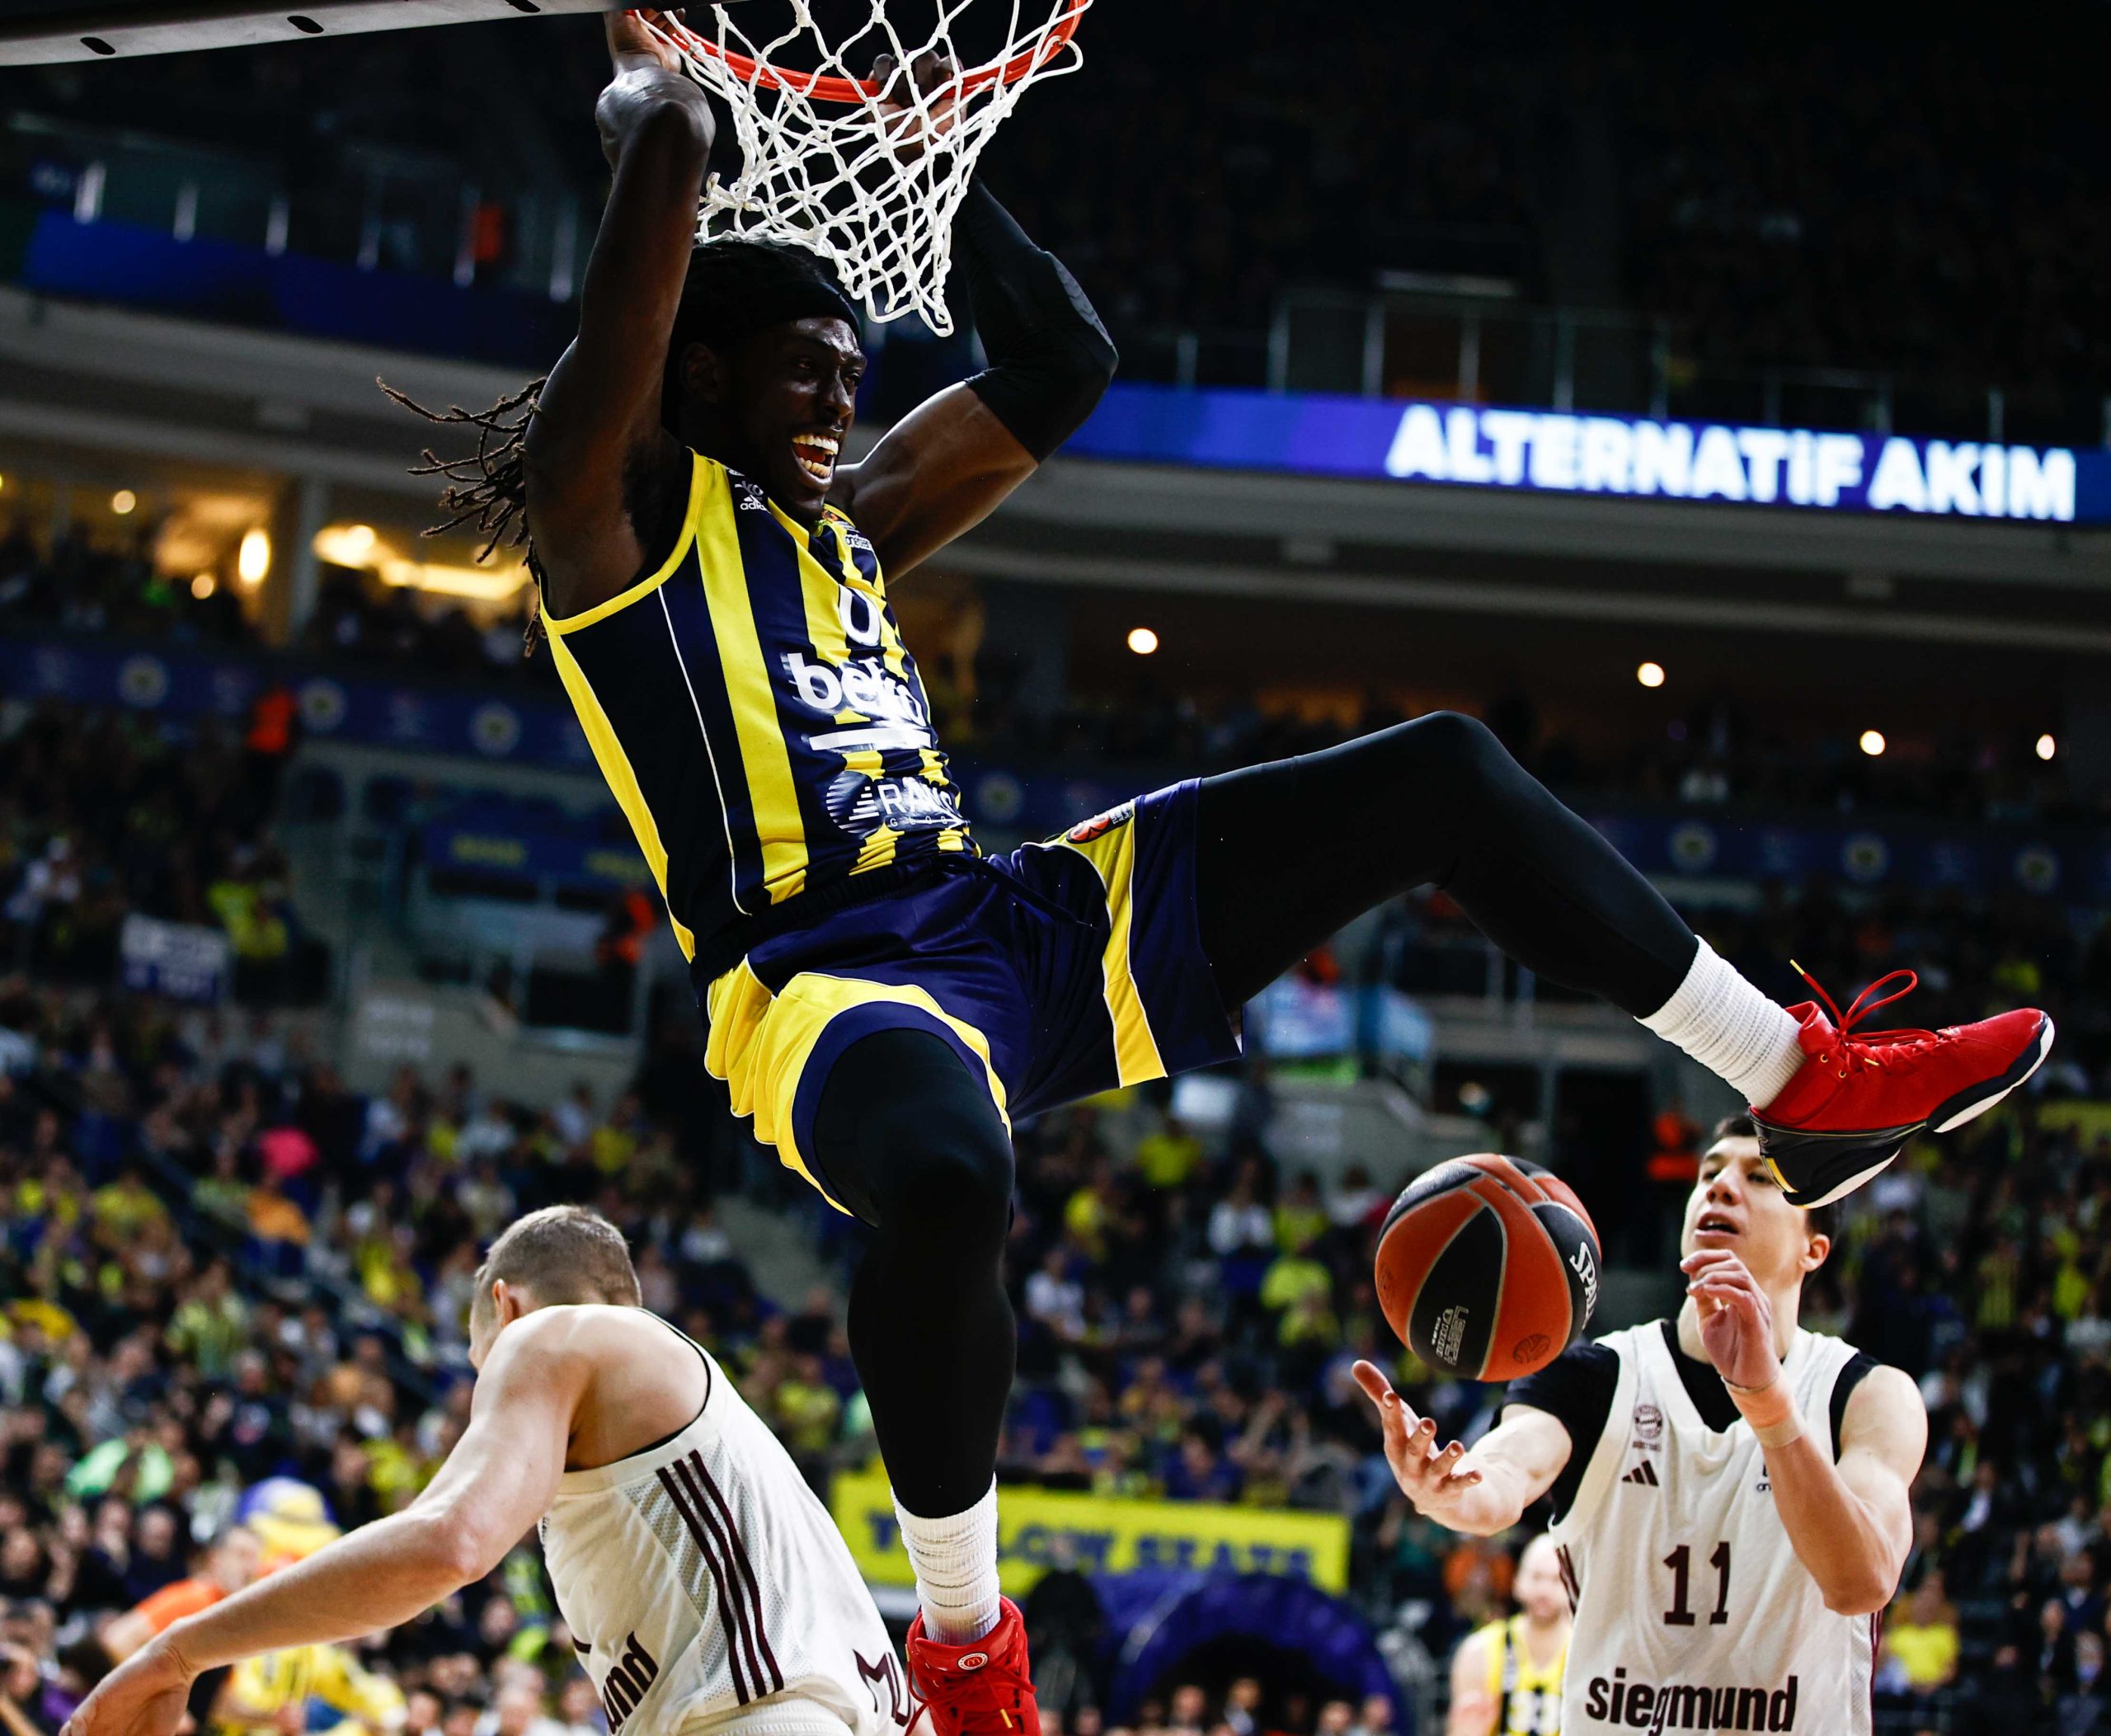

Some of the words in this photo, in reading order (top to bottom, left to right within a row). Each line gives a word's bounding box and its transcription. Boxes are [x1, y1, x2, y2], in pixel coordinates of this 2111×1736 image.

[1867, 435, 2076, 521] AKIM
[838, 584, 881, 647] 0
[788, 652, 926, 727] beko
[1663, 1541, 1731, 1626] 11
[1586, 1667, 1798, 1736] siegmund
